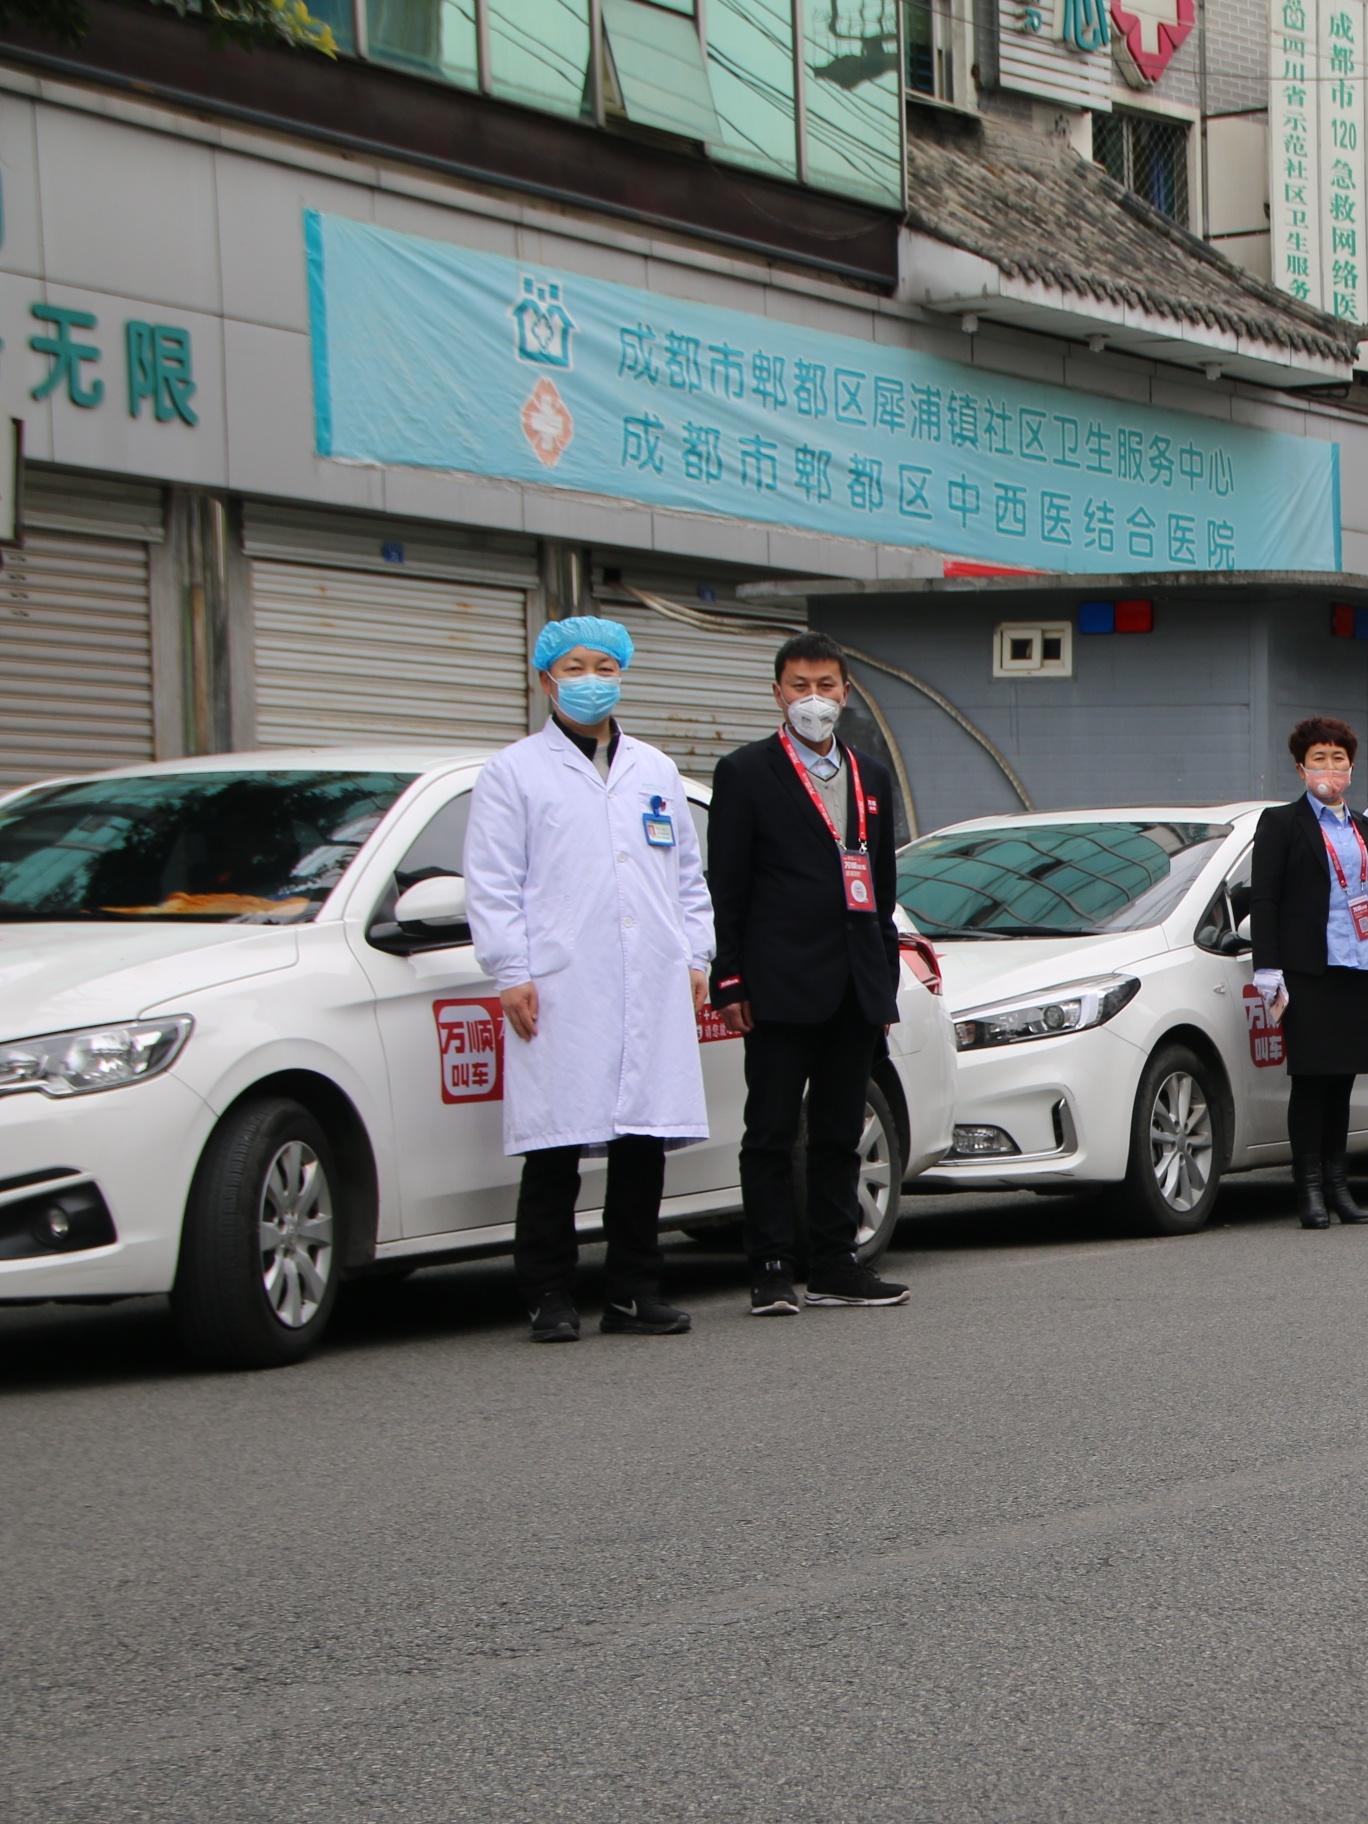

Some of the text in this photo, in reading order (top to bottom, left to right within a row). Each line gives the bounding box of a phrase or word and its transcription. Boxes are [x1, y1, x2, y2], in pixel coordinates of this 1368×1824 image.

[616, 318, 1237, 498] 成都市郫都区犀浦镇社区卫生服务中心
[620, 411, 1237, 572] 成都市郫都区中西医结合医院
[438, 1020, 496, 1055] 万顺
[1255, 1036, 1283, 1061] 叫车
[451, 1062, 489, 1088] 叫车
